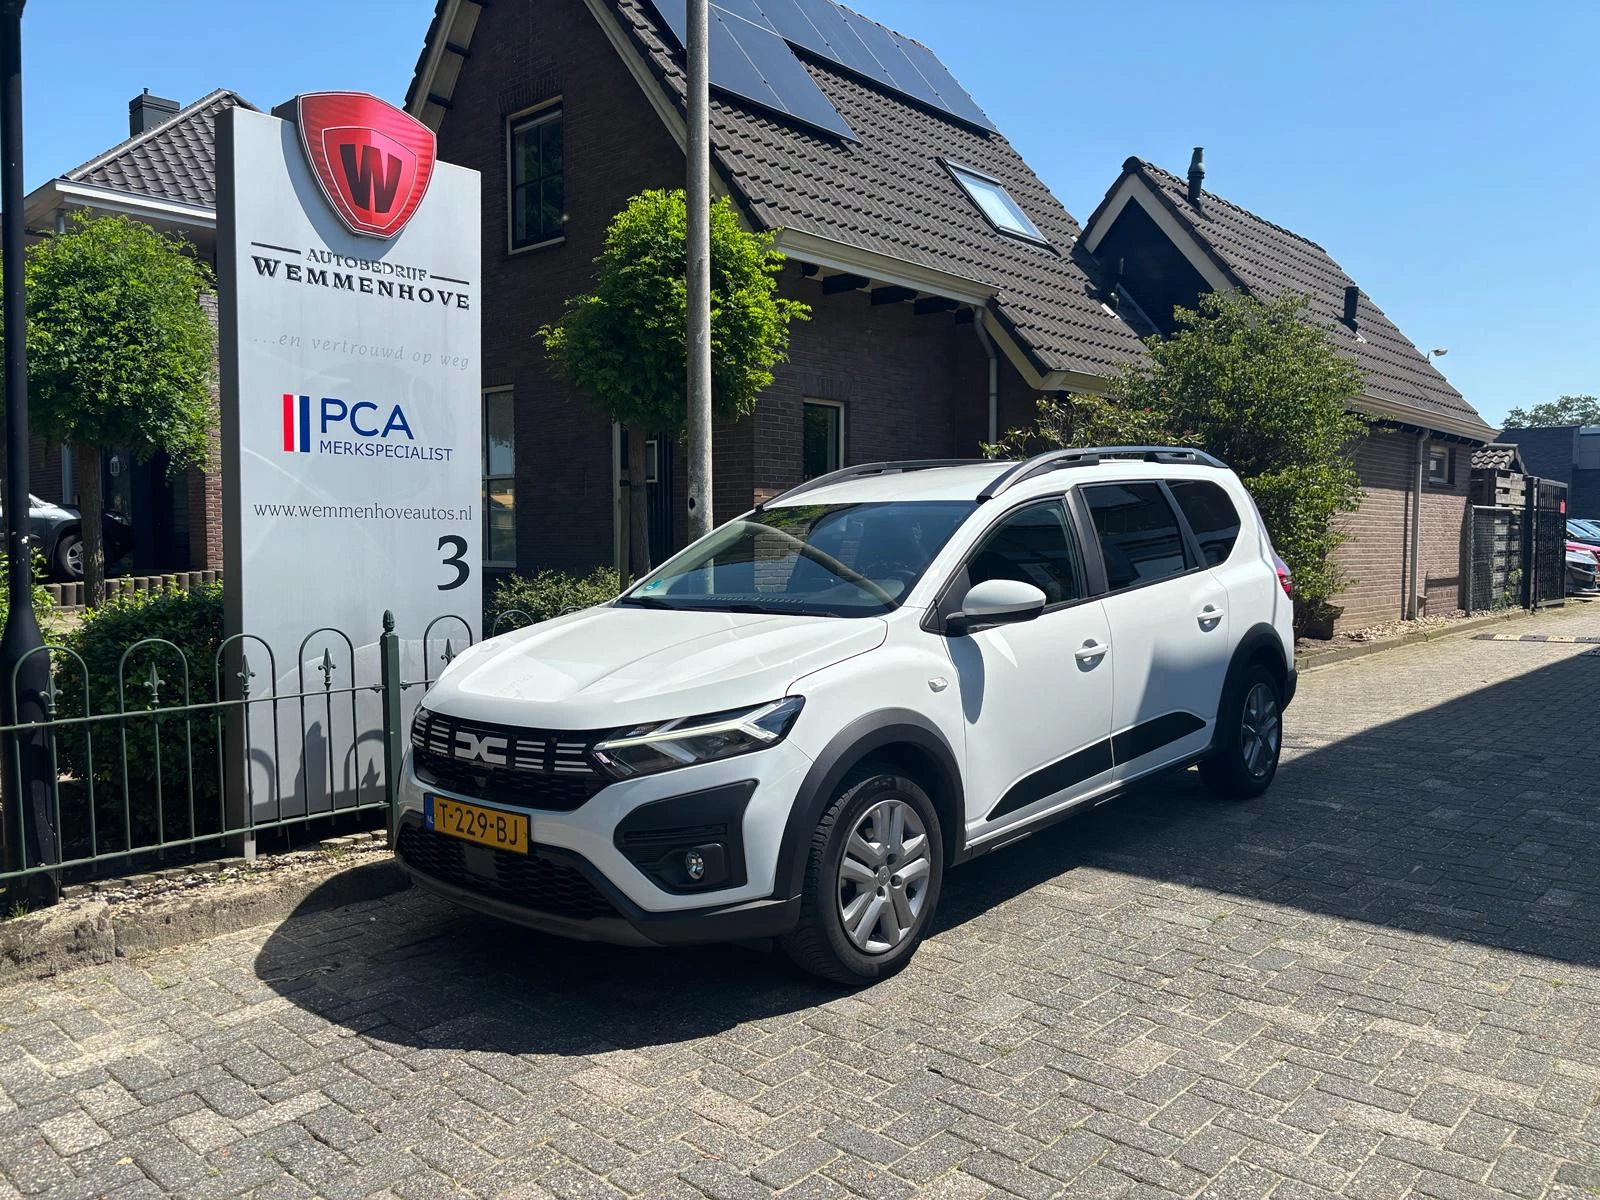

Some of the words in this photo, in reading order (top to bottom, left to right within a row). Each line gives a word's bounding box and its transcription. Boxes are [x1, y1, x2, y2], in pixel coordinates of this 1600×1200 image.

[339, 143, 403, 213] W
[251, 255, 470, 310] WEMMENHOVE
[306, 248, 427, 282] AUTOBEDRIJF
[311, 337, 404, 361] vertrouwd
[412, 352, 432, 366] op
[440, 354, 470, 371] weg
[320, 397, 415, 440] PCA
[319, 440, 453, 461] MERKSPECIALIST
[253, 502, 473, 521] www.wemmenhoveautos.nl
[437, 534, 471, 591] 3
[439, 802, 518, 846] T-229-BJ
